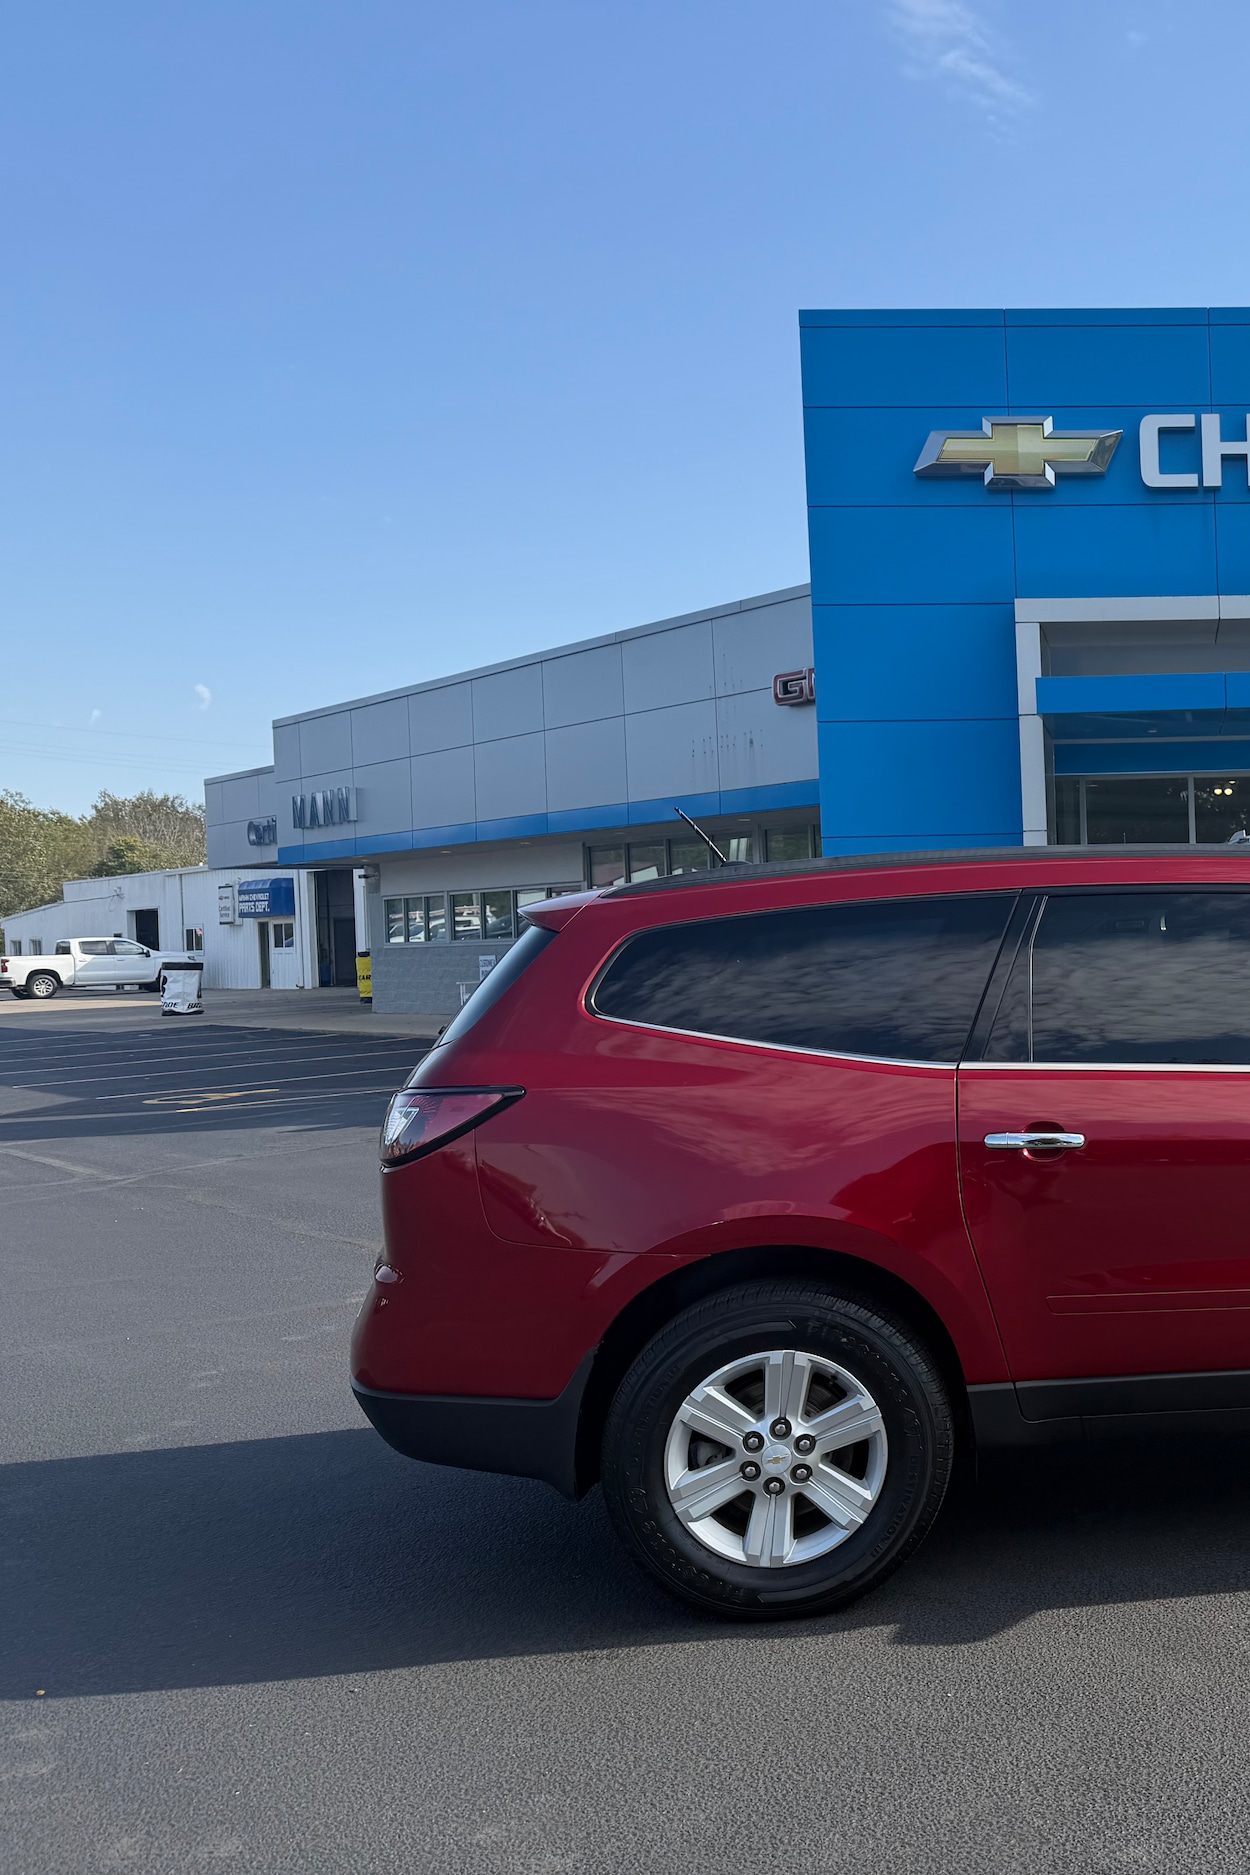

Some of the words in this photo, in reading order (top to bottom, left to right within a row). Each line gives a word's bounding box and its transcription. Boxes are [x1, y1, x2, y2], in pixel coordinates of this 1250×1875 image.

[291, 786, 358, 829] MANN
[239, 902, 255, 913] PARTS
[255, 901, 270, 912] DEPT.
